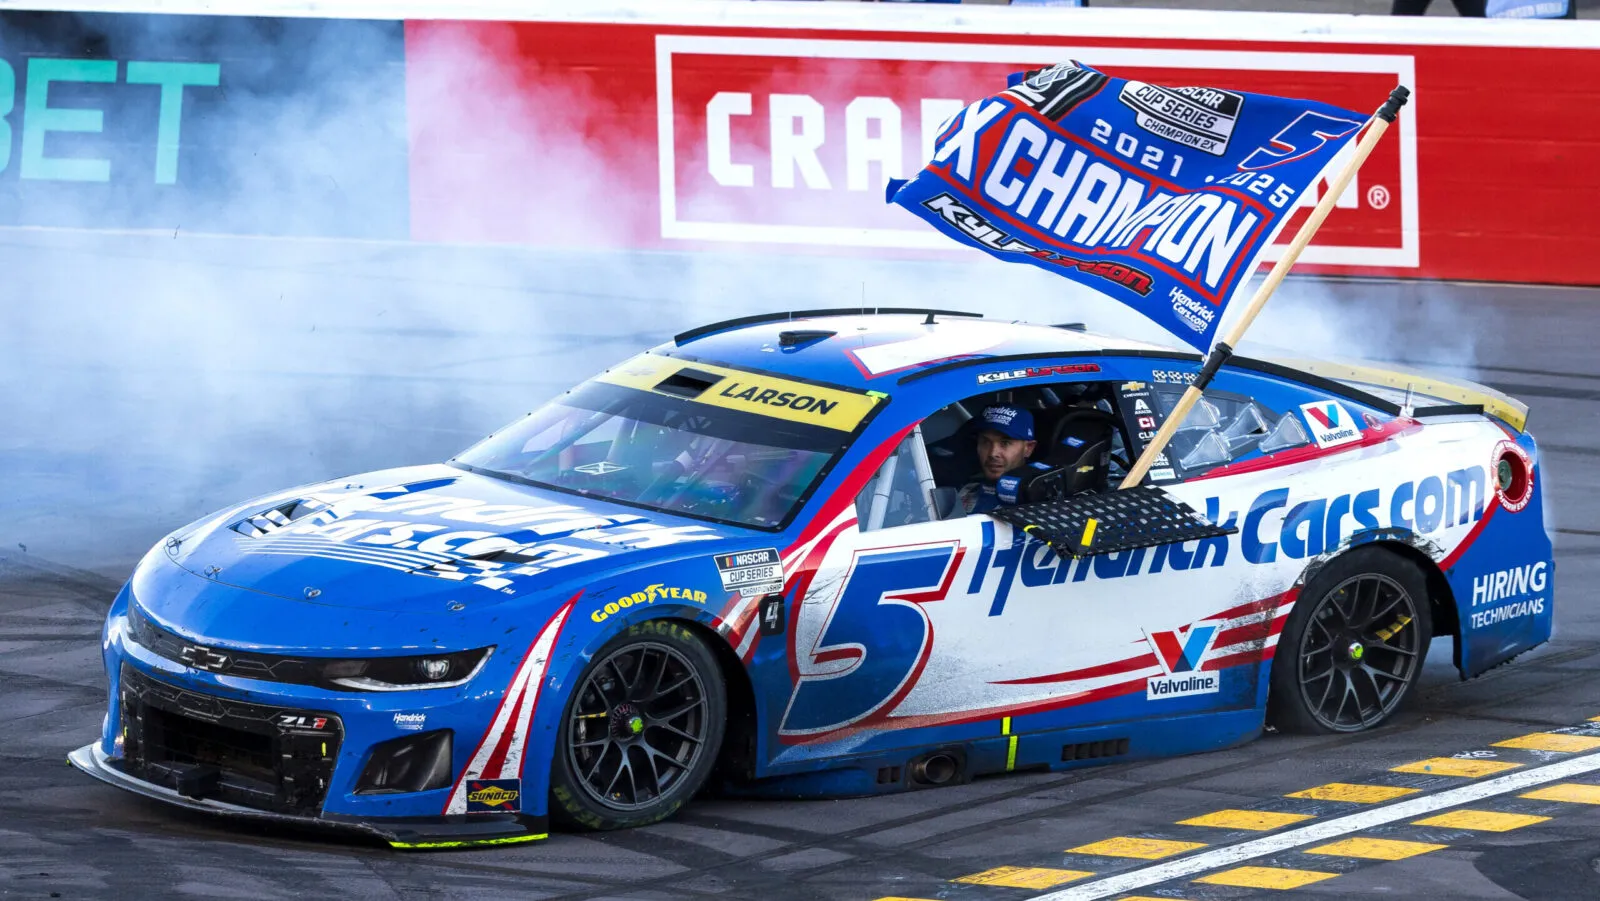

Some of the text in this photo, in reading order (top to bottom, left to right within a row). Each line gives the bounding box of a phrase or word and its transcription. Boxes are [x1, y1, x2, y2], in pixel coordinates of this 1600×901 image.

[0, 58, 220, 184] ET
[1136, 86, 1218, 129] CUP SERIES
[1090, 118, 1184, 177] 2021
[1144, 118, 1218, 151] CHAMPION 2X
[1237, 111, 1362, 172] 5
[934, 100, 1258, 289] X CHAMPION
[1216, 171, 1296, 208] 2025
[1169, 286, 1216, 323] Hendrick
[1172, 302, 1208, 330] Cars.com
[719, 382, 839, 415] LARSON
[1320, 429, 1354, 443] Valvoline
[729, 567, 775, 582] CUP SERIES
[735, 551, 770, 566] NASCAR
[1472, 561, 1548, 607] HIRING
[590, 583, 708, 623] GOODYEAR
[1471, 597, 1545, 630] TECHNICIANS
[628, 619, 693, 642] EAGLE
[778, 540, 968, 743] 5
[1150, 676, 1214, 695] Valvoline
[393, 712, 427, 724] Hendrick
[470, 791, 517, 801] SUNOCO
